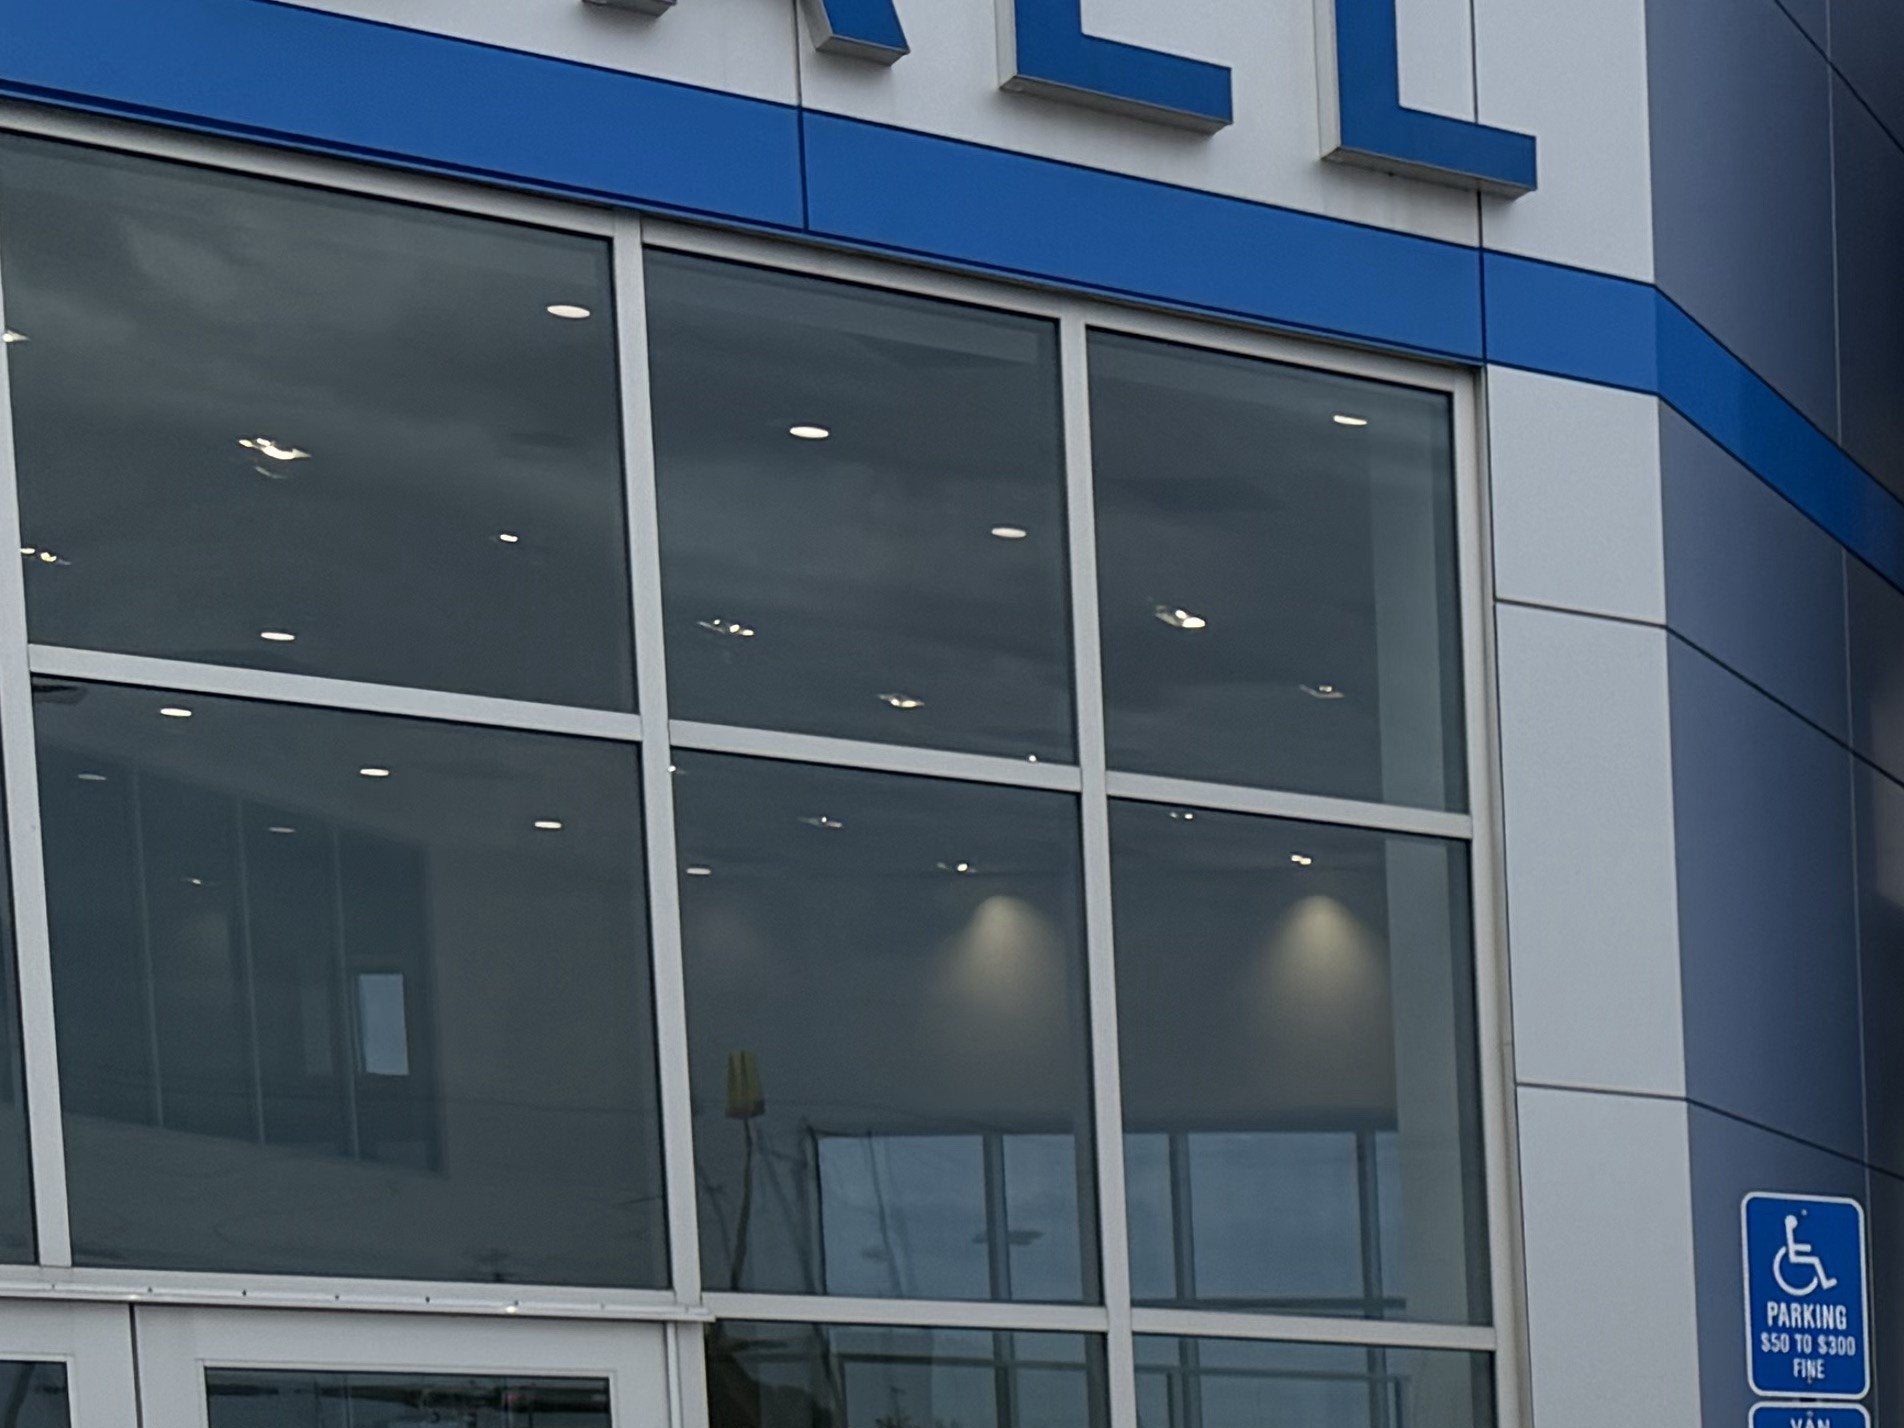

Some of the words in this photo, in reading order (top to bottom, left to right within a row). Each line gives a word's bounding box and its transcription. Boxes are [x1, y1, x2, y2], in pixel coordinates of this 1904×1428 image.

[1766, 1302, 1847, 1331] PARKING
[1761, 1332, 1790, 1353] $50
[1794, 1333, 1812, 1354] TO
[1817, 1335, 1856, 1357] $300
[1793, 1358, 1825, 1380] FINE
